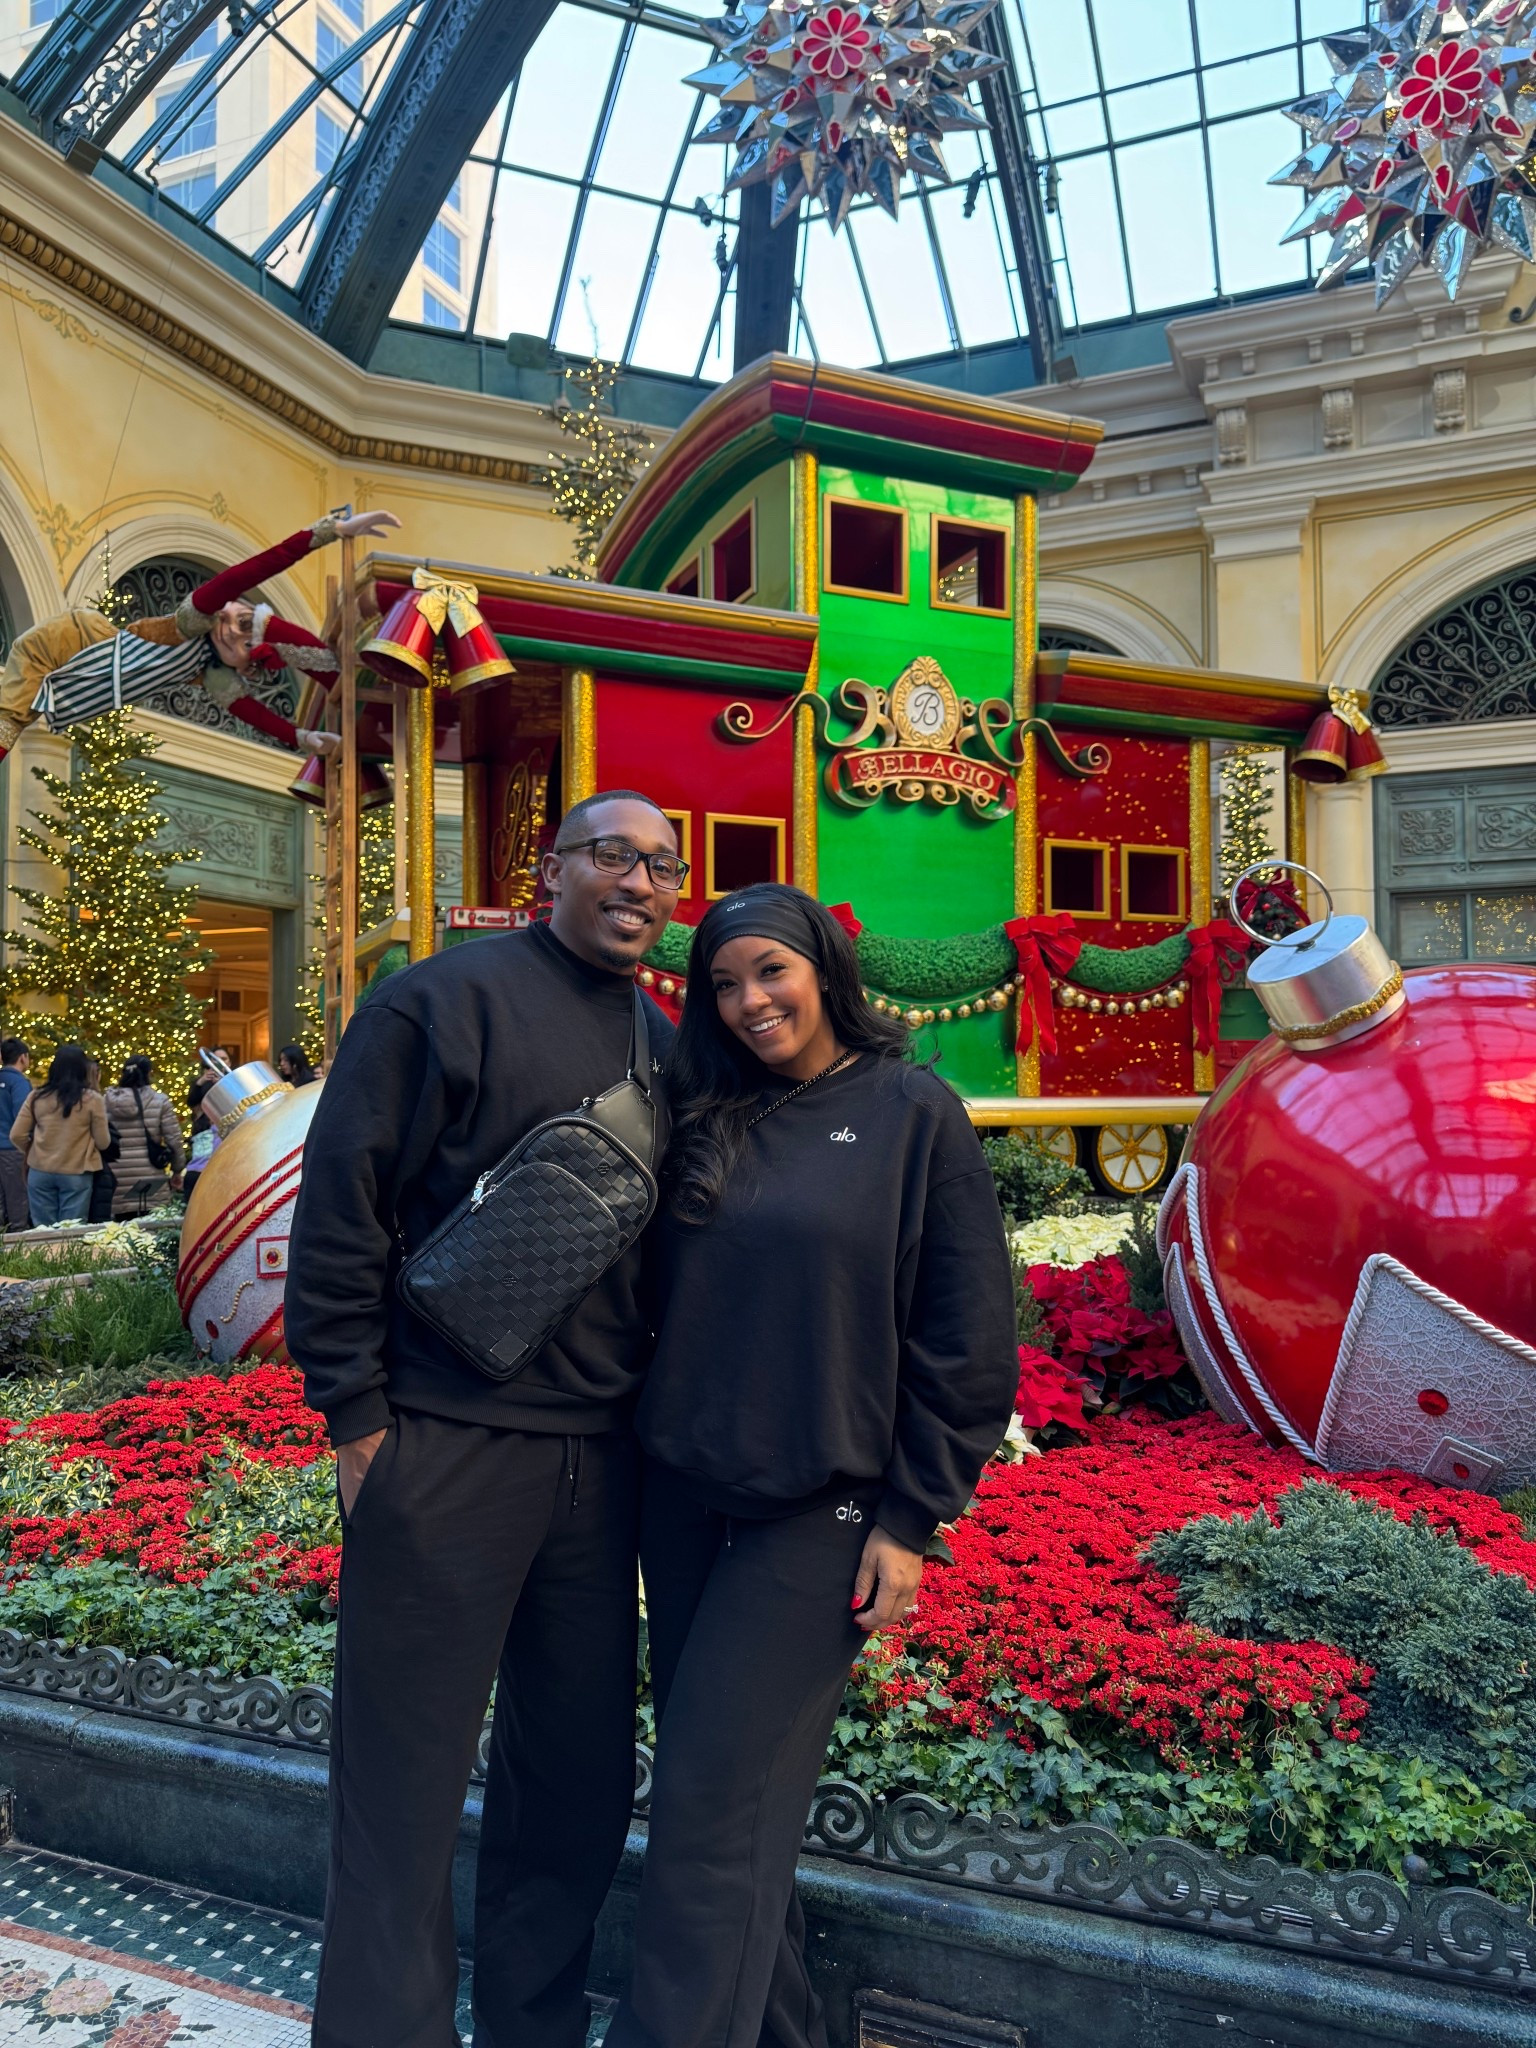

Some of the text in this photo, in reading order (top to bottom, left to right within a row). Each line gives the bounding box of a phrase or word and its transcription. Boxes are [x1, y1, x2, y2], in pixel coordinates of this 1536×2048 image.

[911, 692, 940, 726] B
[857, 754, 995, 791] BELLAGIO
[726, 901, 746, 912] alo
[830, 1126, 857, 1143] alo
[835, 1500, 862, 1523] alo
